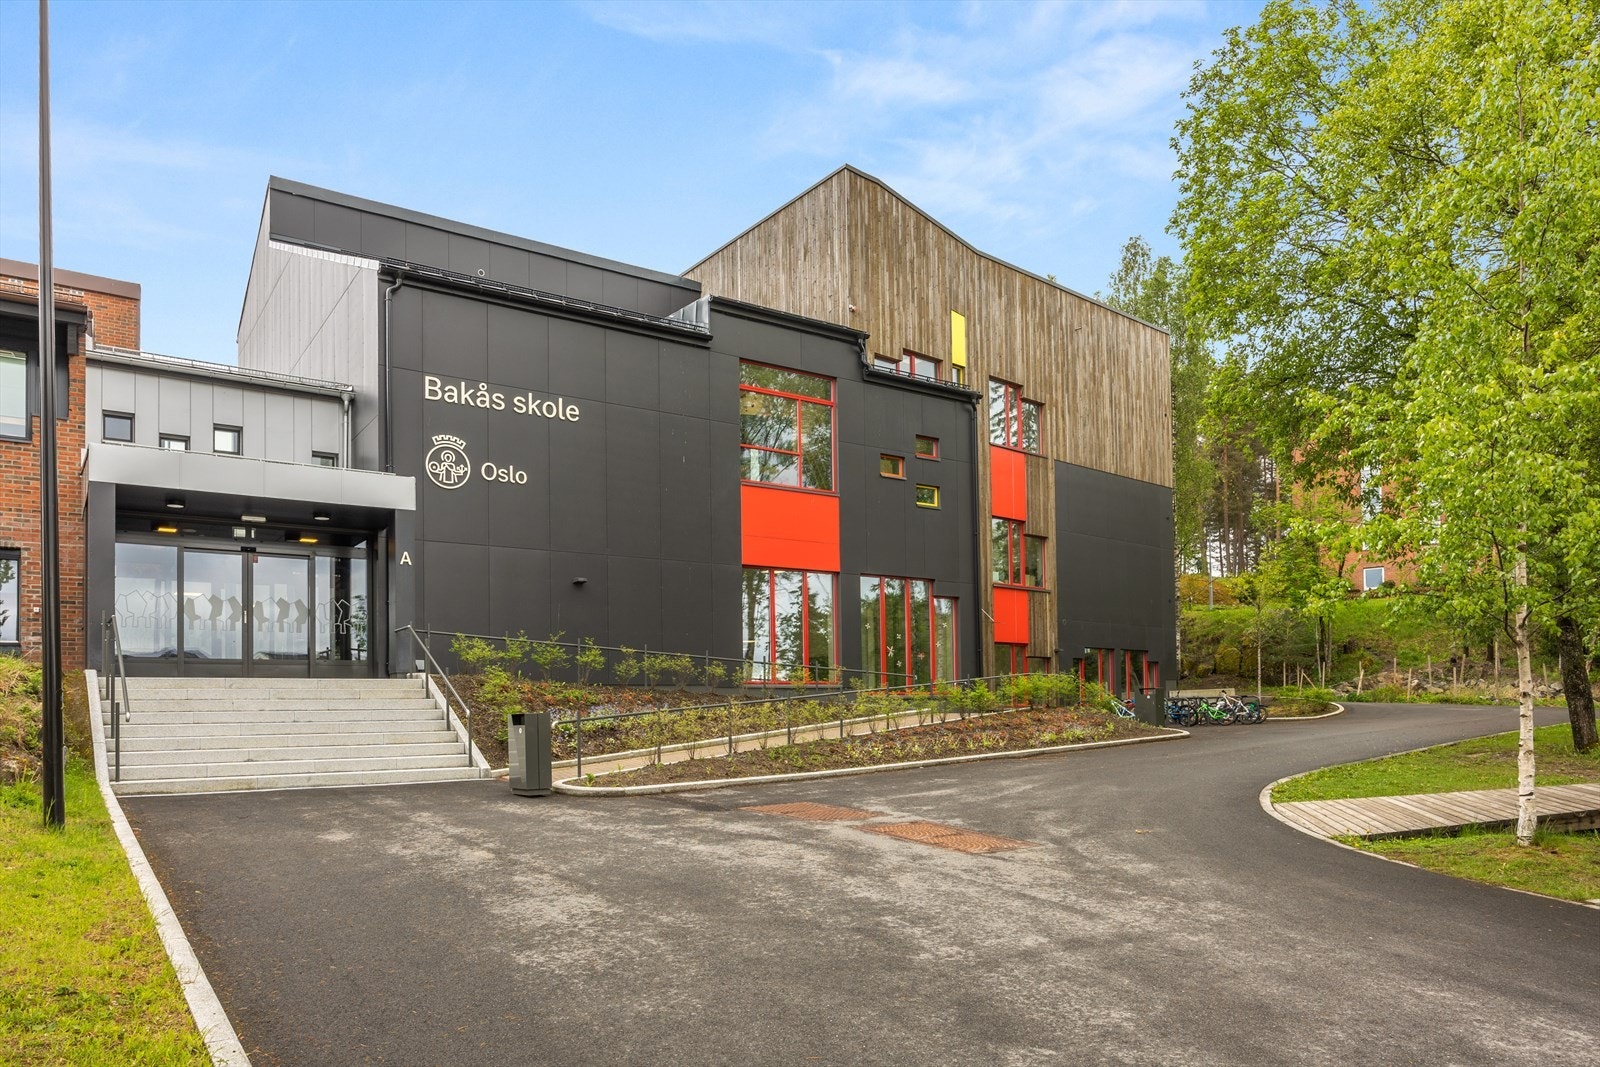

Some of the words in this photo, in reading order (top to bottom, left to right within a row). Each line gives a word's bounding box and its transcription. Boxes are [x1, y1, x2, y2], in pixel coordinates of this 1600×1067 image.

[424, 375, 506, 411] Bakås
[513, 392, 580, 422] skole
[481, 462, 528, 485] Oslo
[399, 551, 413, 566] A
